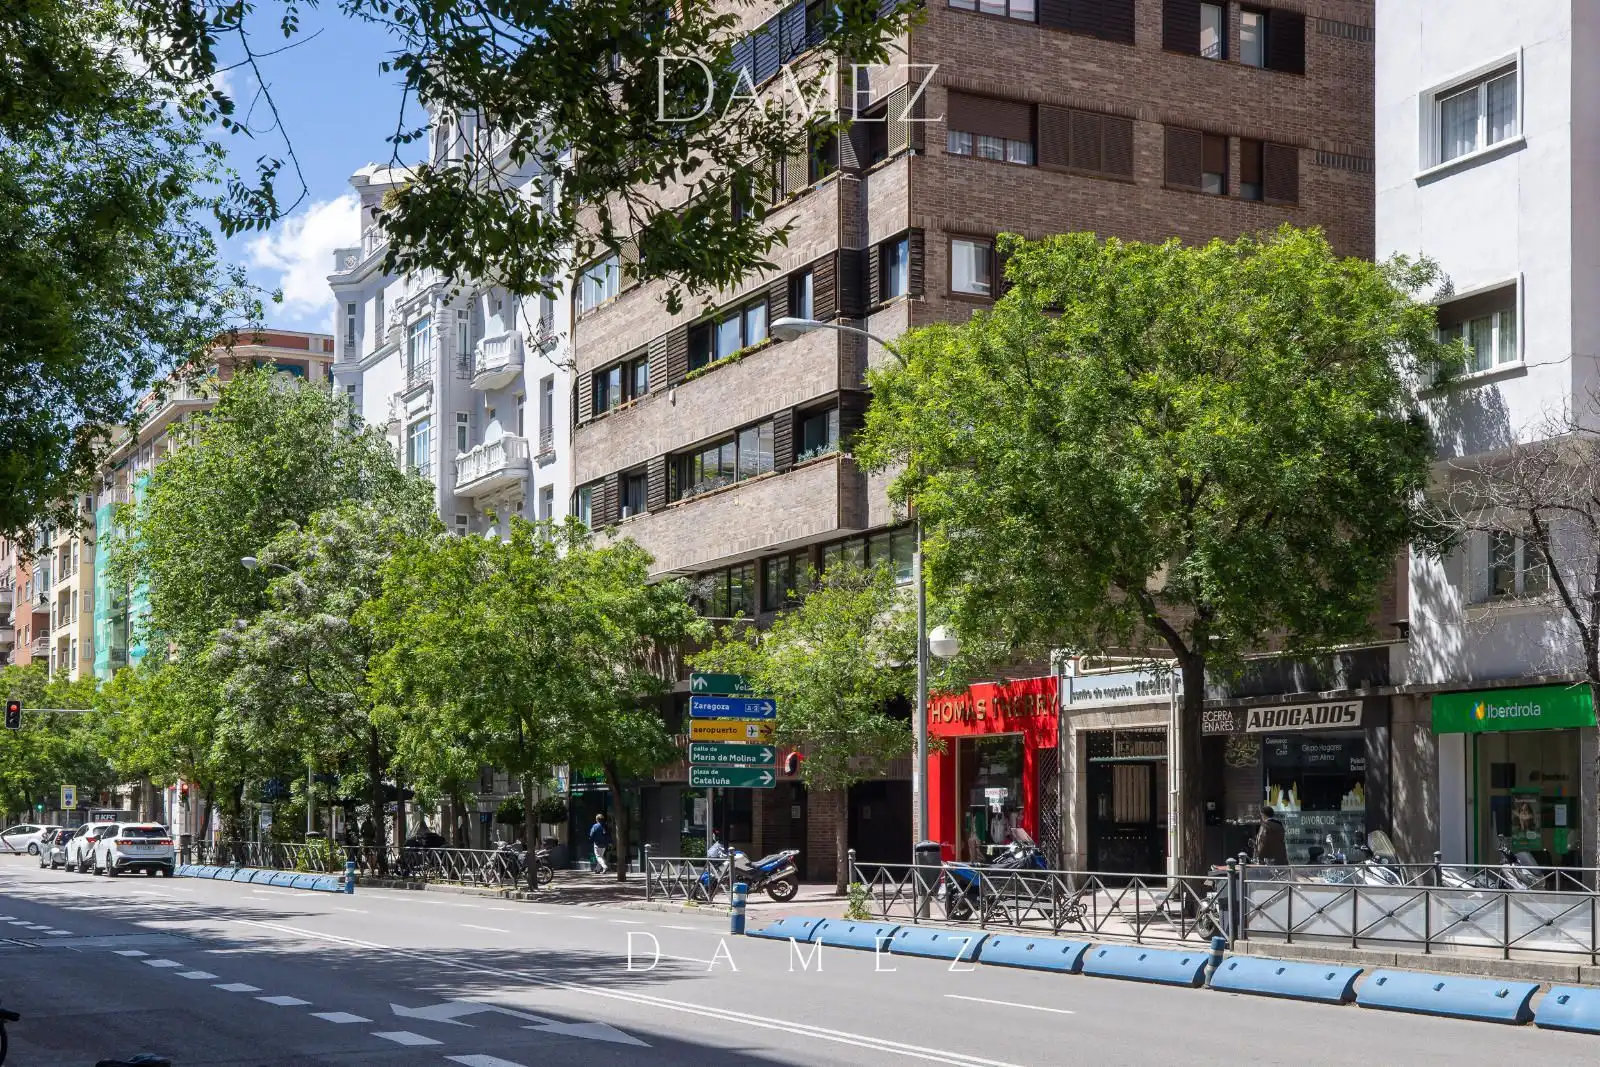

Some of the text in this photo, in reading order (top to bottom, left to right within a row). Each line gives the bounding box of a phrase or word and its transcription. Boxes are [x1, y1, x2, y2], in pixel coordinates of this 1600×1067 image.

[693, 702, 730, 711] Zaragoza
[1487, 701, 1541, 719] Iberdrola
[1248, 704, 1357, 729] ABOGADOS
[693, 777, 731, 785] Cataluña
